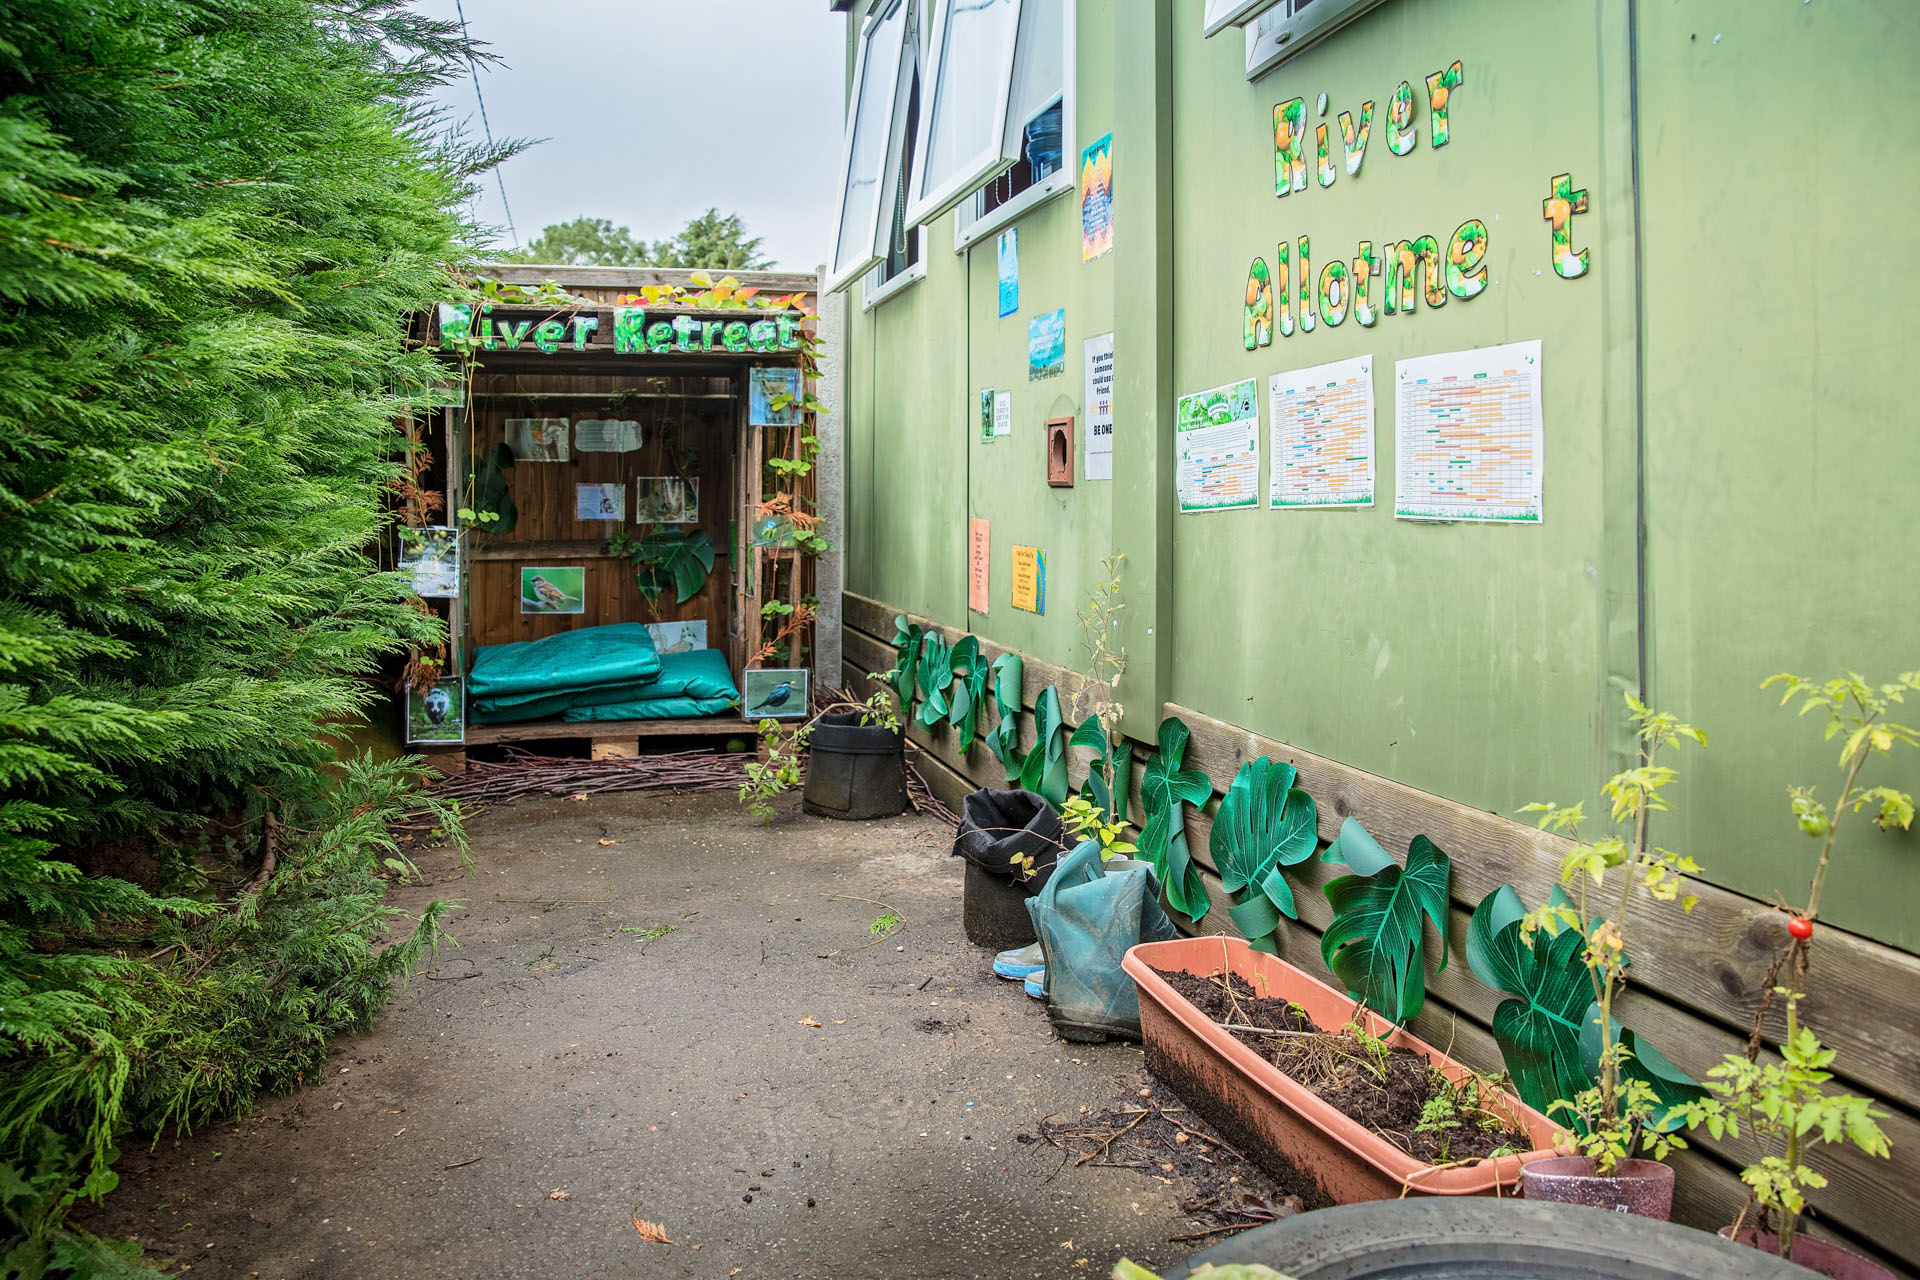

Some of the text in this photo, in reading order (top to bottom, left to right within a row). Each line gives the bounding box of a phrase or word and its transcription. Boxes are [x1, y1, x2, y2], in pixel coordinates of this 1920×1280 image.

[1272, 60, 1463, 198] River
[439, 301, 801, 354] River Retreat
[1094, 364, 1112, 374] someone
[1093, 375, 1103, 385] could
[1103, 375, 1111, 383] use
[1094, 423, 1112, 436] BE ONE
